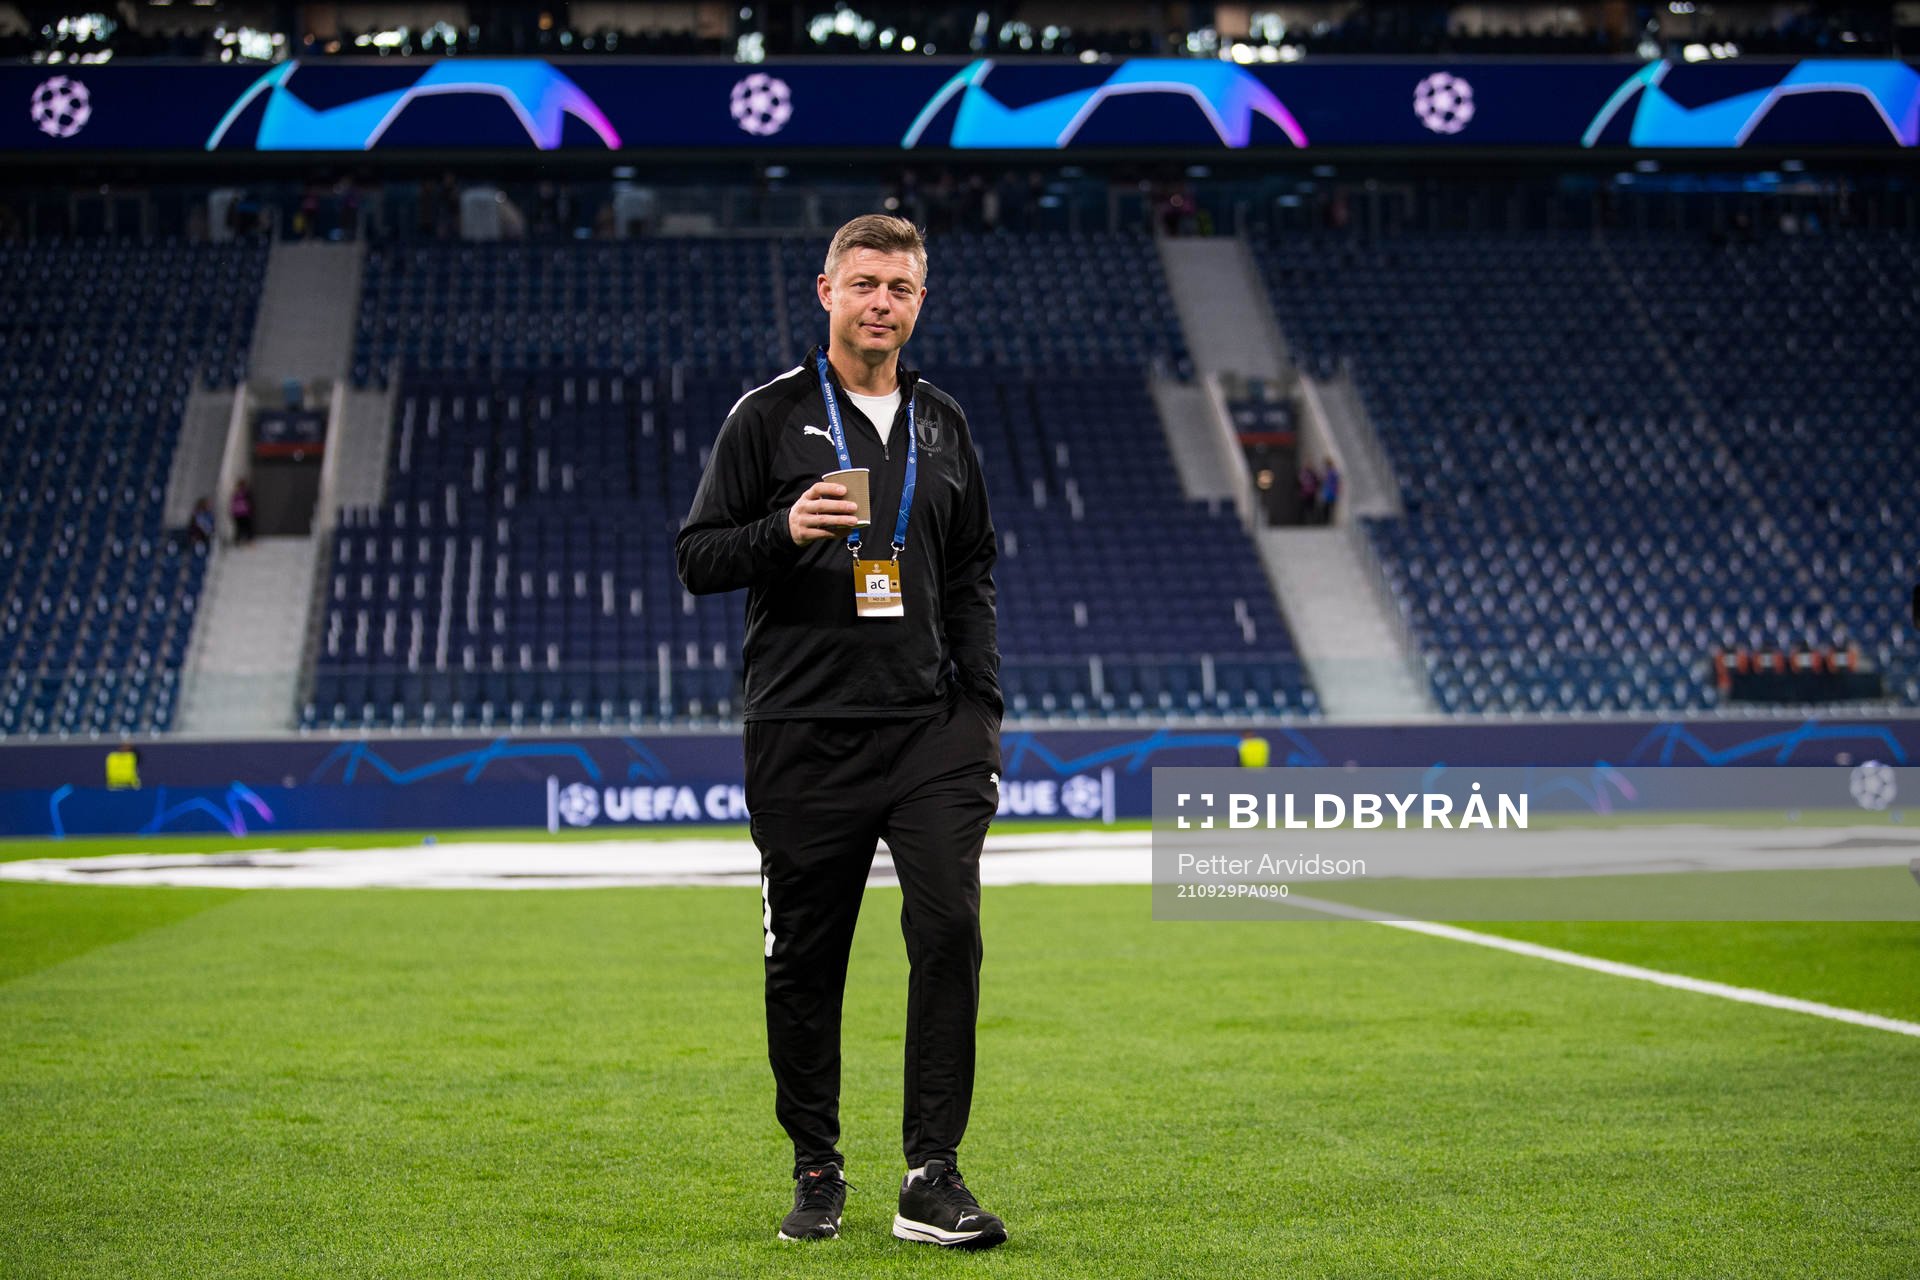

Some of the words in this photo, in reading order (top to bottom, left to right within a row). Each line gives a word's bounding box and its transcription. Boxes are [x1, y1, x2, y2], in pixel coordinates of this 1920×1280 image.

[828, 403, 841, 435] CHAMPIONS
[835, 435, 844, 450] UEFA
[870, 579, 886, 590] aC
[603, 786, 701, 822] UEFA
